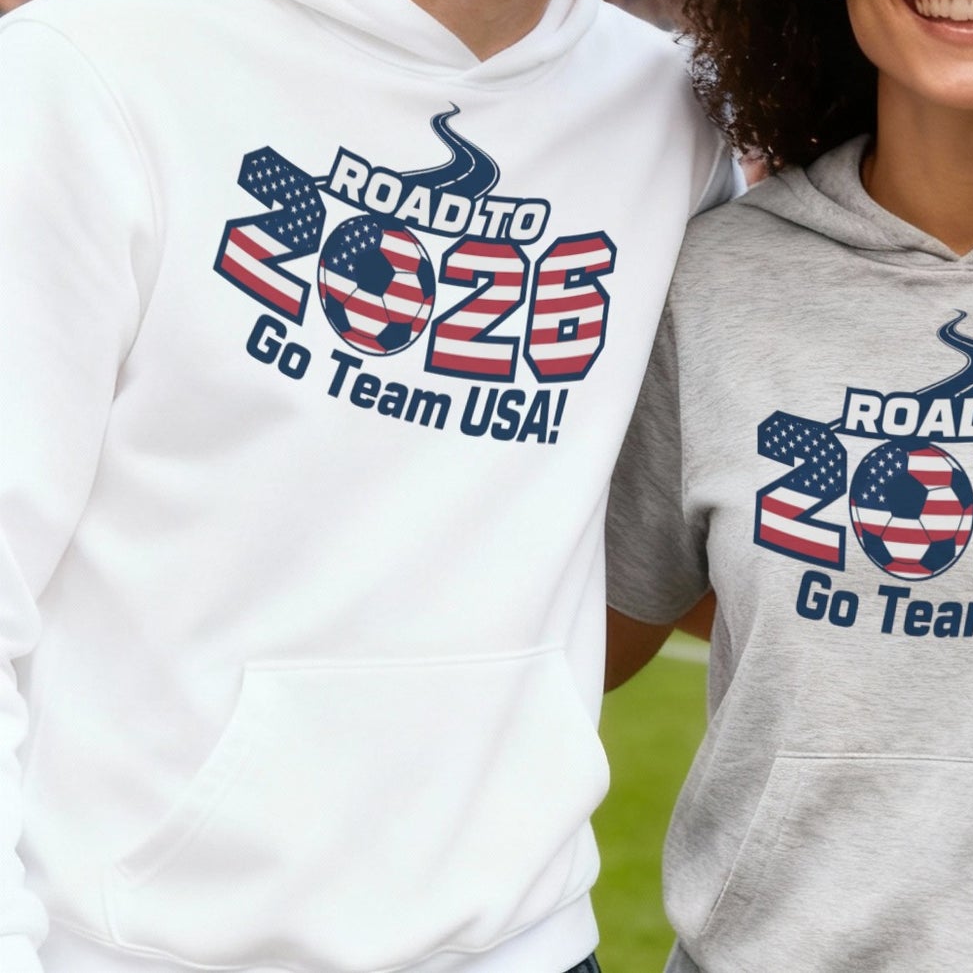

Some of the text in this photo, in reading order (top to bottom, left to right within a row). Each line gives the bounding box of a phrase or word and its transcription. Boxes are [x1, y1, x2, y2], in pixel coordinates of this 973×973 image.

[328, 148, 549, 243] ROAD TO
[213, 145, 617, 383] 2026
[246, 313, 569, 444] Go Team USA!
[796, 570, 859, 627] Go
